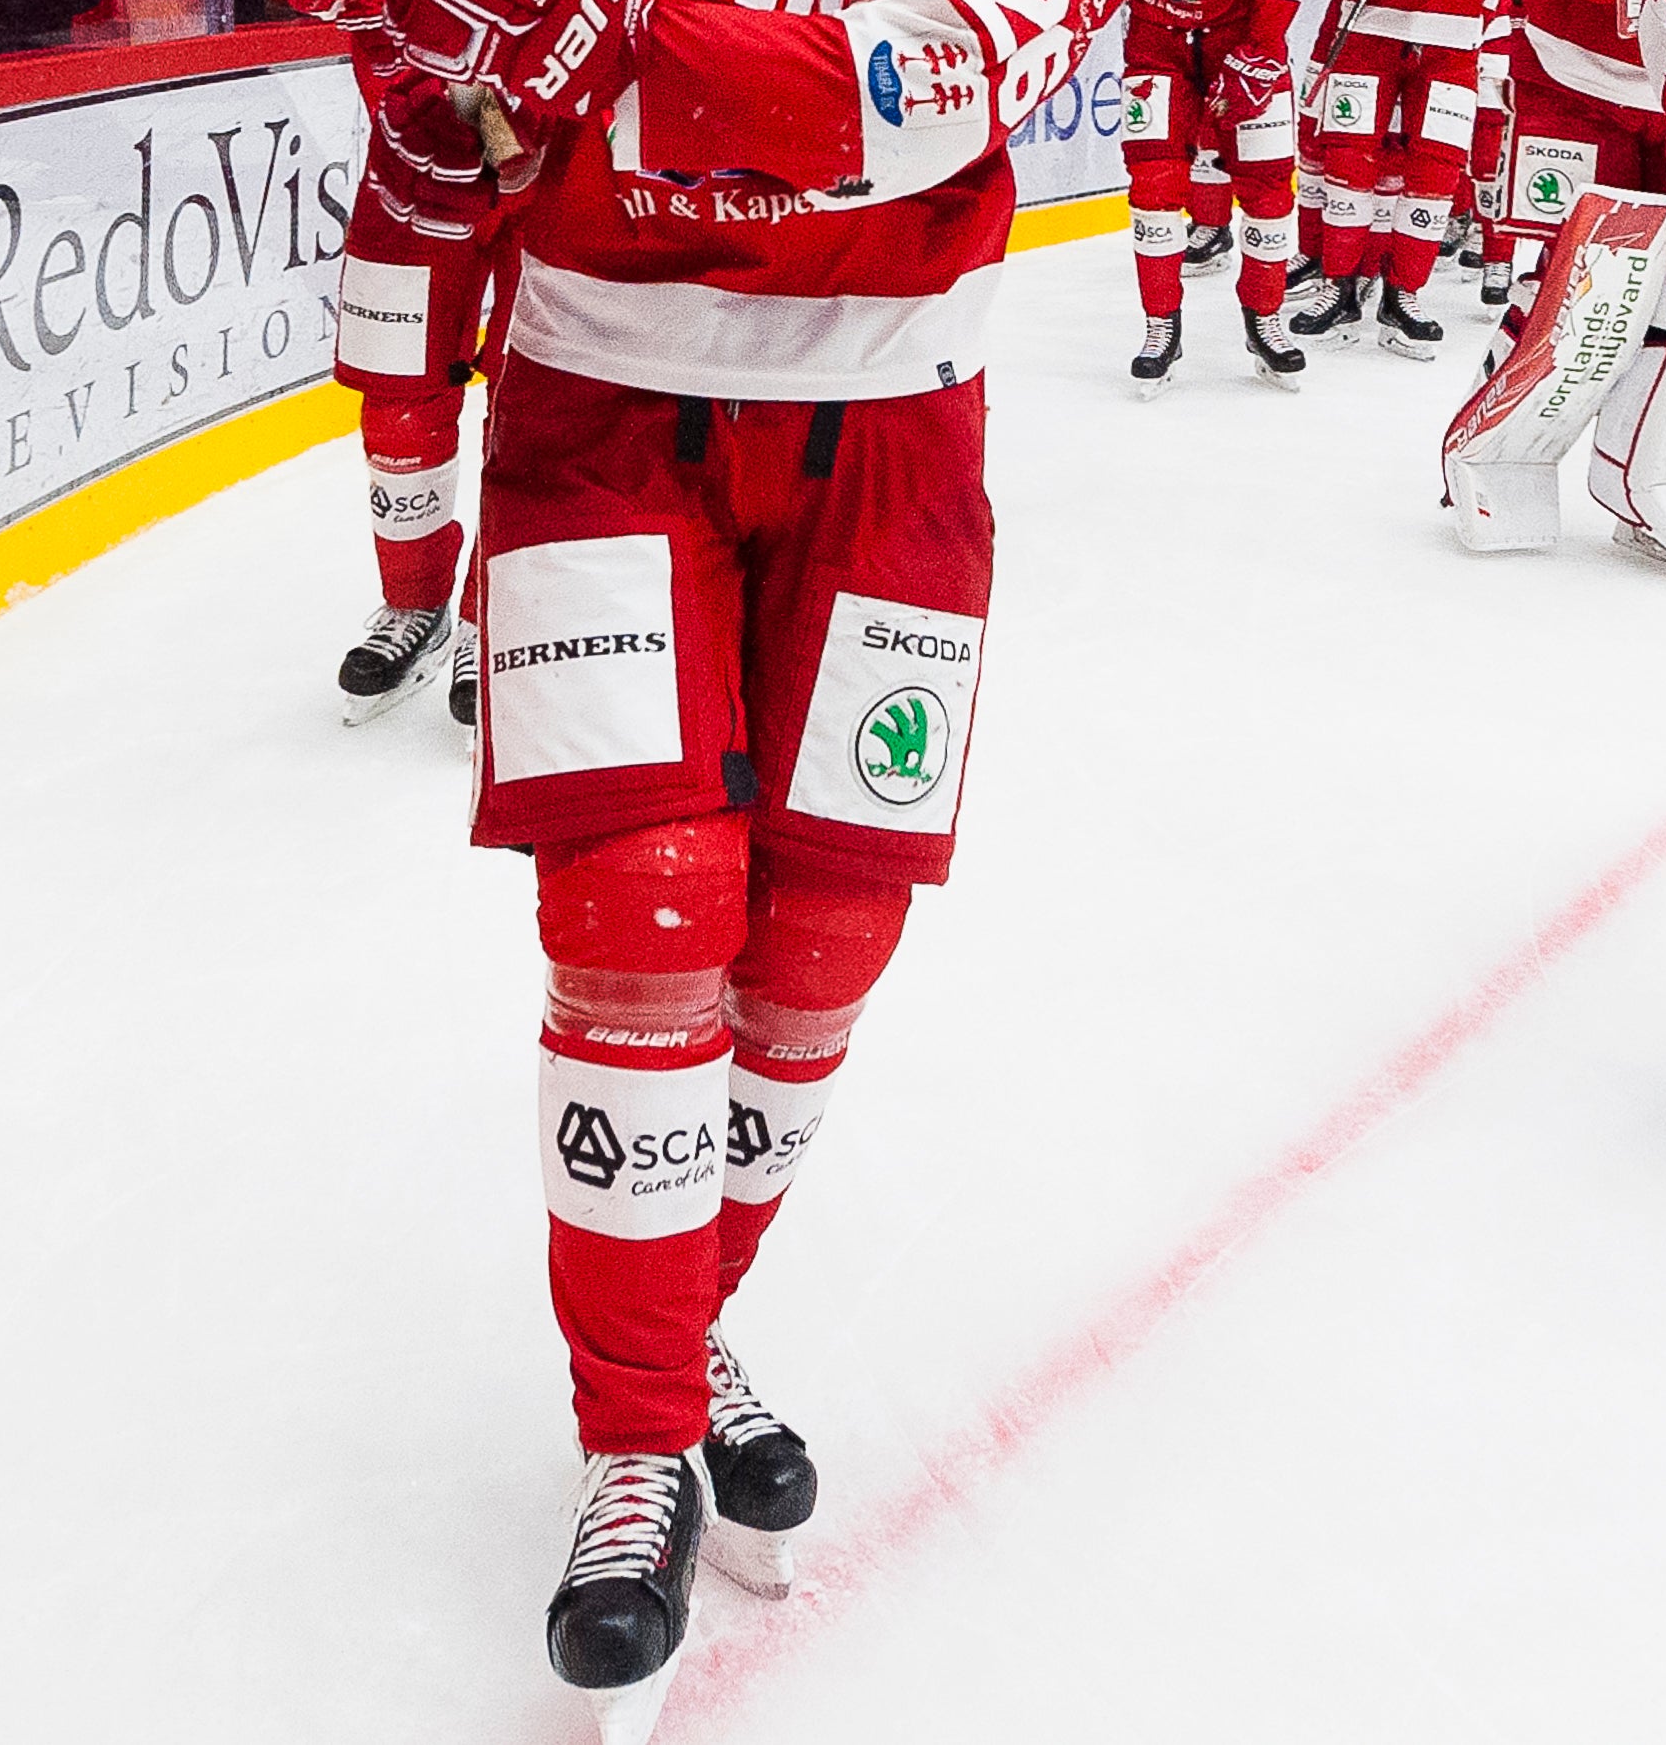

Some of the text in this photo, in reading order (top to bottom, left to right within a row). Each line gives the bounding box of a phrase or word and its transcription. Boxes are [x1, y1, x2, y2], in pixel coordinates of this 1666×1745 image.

[668, 195, 700, 221] &
[1538, 301, 1611, 419] norrlands
[395, 486, 440, 515] SCA
[493, 631, 667, 675] BERNERS
[862, 624, 972, 666] ŠKODA
[631, 1120, 716, 1171] SCA
